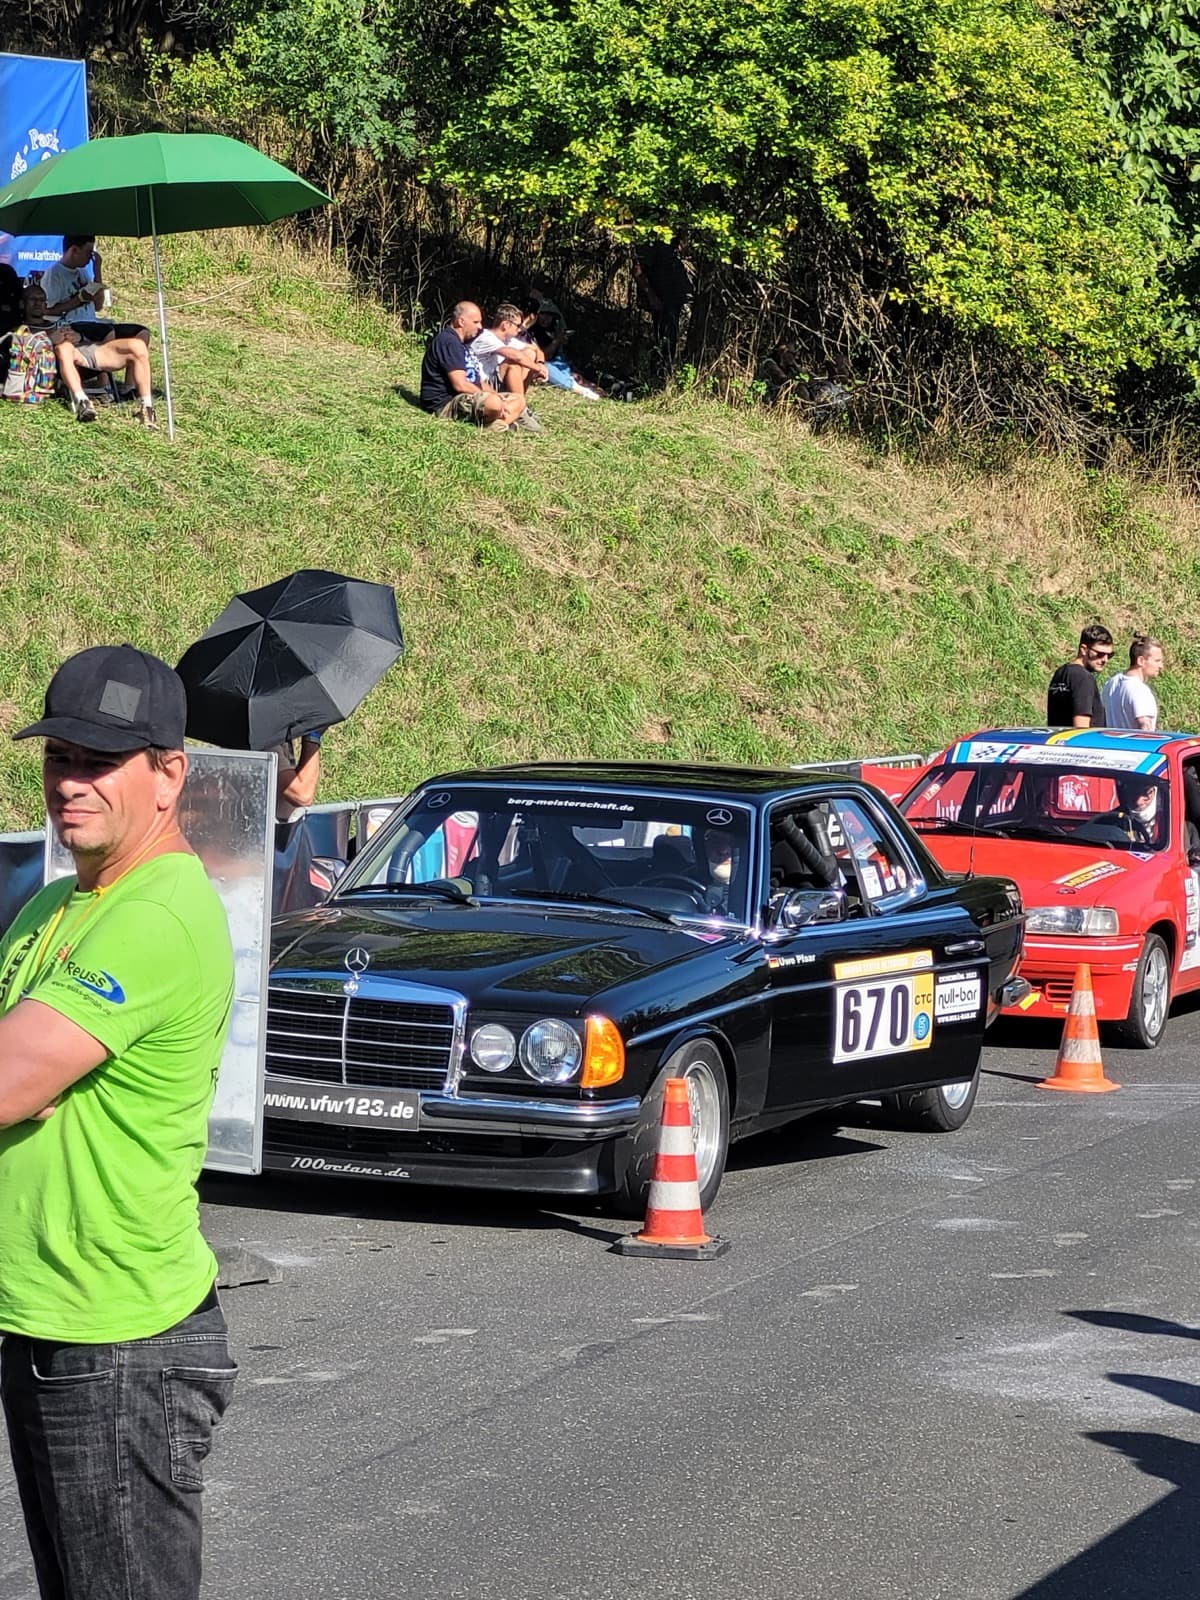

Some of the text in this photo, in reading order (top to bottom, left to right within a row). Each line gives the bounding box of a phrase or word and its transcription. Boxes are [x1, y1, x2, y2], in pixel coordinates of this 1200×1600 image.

[507, 798, 635, 811] berg-meisterschaft.de
[914, 993, 932, 1005] CTC
[841, 984, 910, 1053] 670
[264, 1093, 414, 1118] www.vfw123.de
[290, 1157, 411, 1178] 100octane.de
